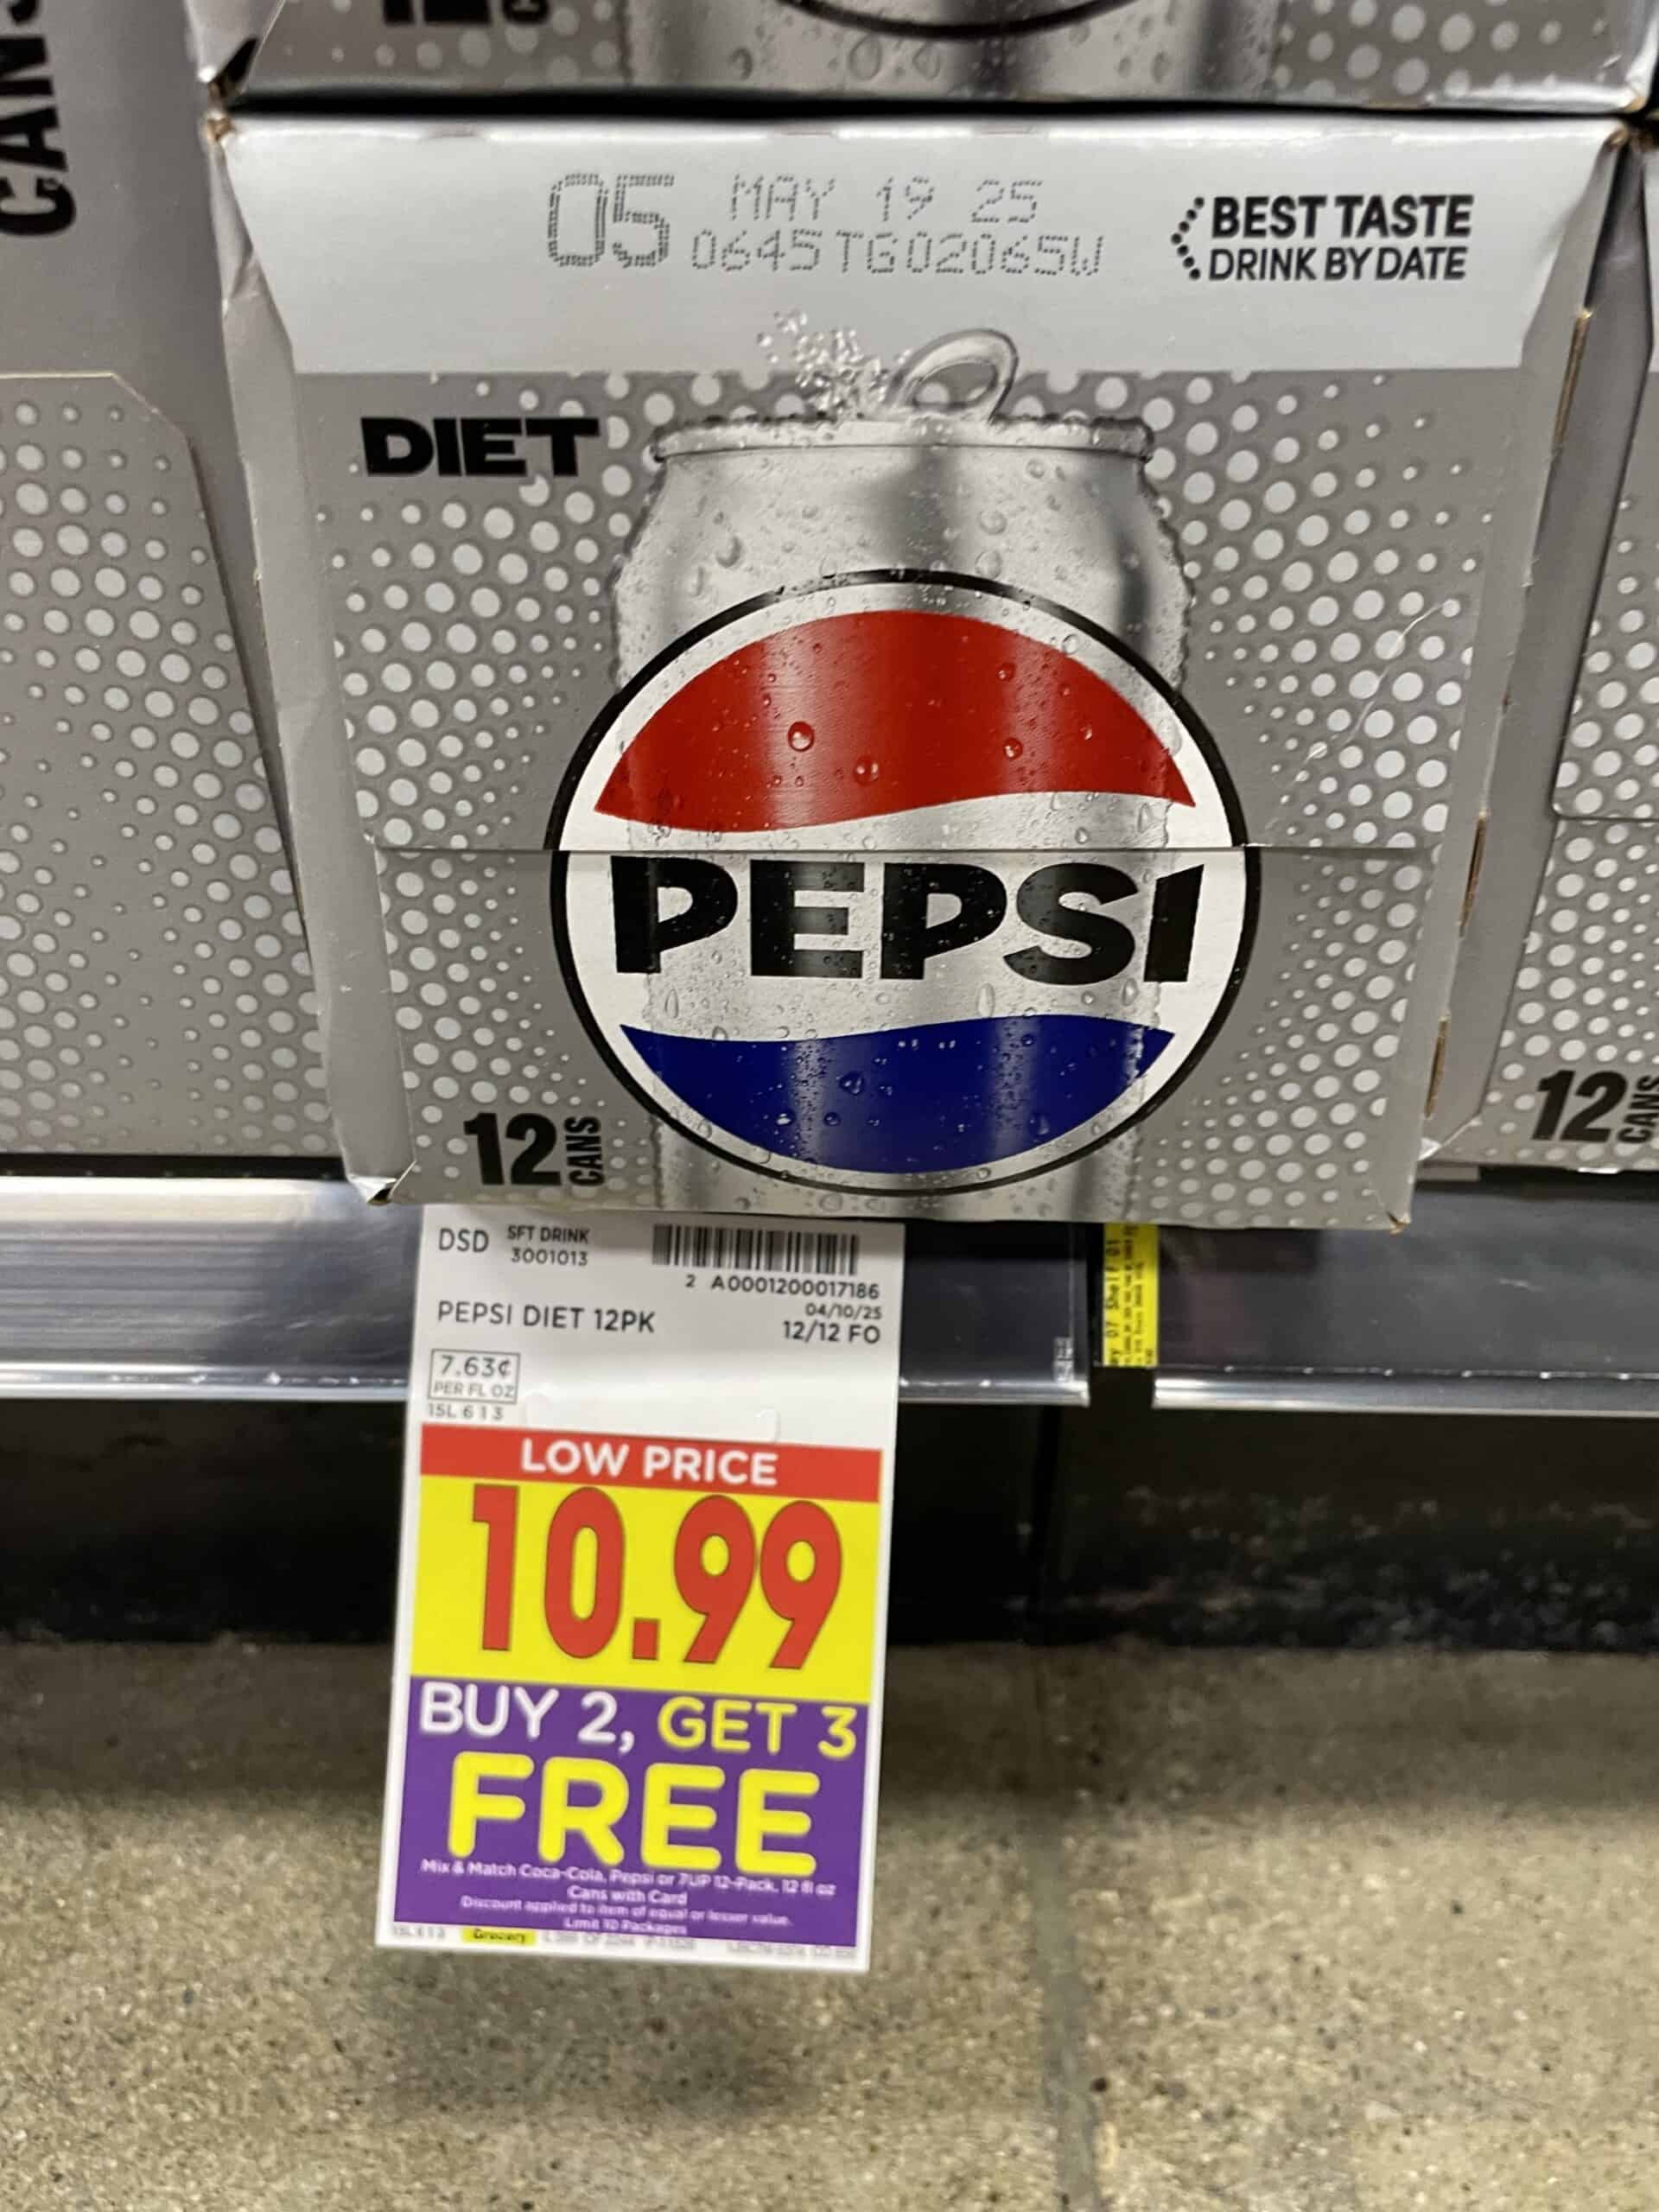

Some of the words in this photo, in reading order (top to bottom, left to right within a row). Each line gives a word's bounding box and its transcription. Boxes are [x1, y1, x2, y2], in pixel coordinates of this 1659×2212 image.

[732, 175, 836, 220] MAY
[874, 175, 935, 221] 19
[971, 179, 1043, 223] 25
[1211, 195, 1326, 238] BEST
[1334, 194, 1474, 238] TASTE
[548, 173, 674, 268] 05
[1209, 247, 1317, 280] DRINK
[1325, 247, 1372, 280] BY
[1376, 246, 1469, 280] DATE
[360, 417, 600, 477] DIET
[610, 854, 1205, 985] PEPSI
[1531, 1070, 1628, 1143] 12
[463, 1112, 563, 1185] 12
[563, 1116, 605, 1187] CANS
[438, 1227, 489, 1253] DSD
[506, 1224, 536, 1242] SFT
[539, 1225, 589, 1244] DRINK
[511, 1247, 588, 1267] 3001013
[685, 1274, 695, 1287] 2
[711, 1274, 880, 1300] A0001200017186
[438, 1300, 512, 1326] PEPSI
[523, 1304, 584, 1330] DIET
[594, 1308, 656, 1333] 12PK
[805, 1302, 882, 1321] 04/10/25
[784, 1319, 841, 1343] 12/12
[848, 1325, 881, 1344] FO
[441, 1354, 512, 1377] 7.63¢
[434, 1380, 464, 1395] PER
[467, 1382, 486, 1397] FL
[491, 1384, 514, 1399] OZ
[520, 1438, 630, 1479] LOW
[642, 1446, 779, 1487] PRICE
[472, 1483, 843, 1670] 10.99
[419, 1681, 560, 1740] BUY
[576, 1691, 636, 1754] 2,
[657, 1696, 797, 1754] GET
[817, 1706, 858, 1759] 3
[446, 1750, 822, 1877] FREE
[420, 1859, 449, 1874] Mix
[467, 1861, 517, 1877] Match
[567, 1885, 608, 1900] Cans
[648, 1889, 688, 1905] Card
